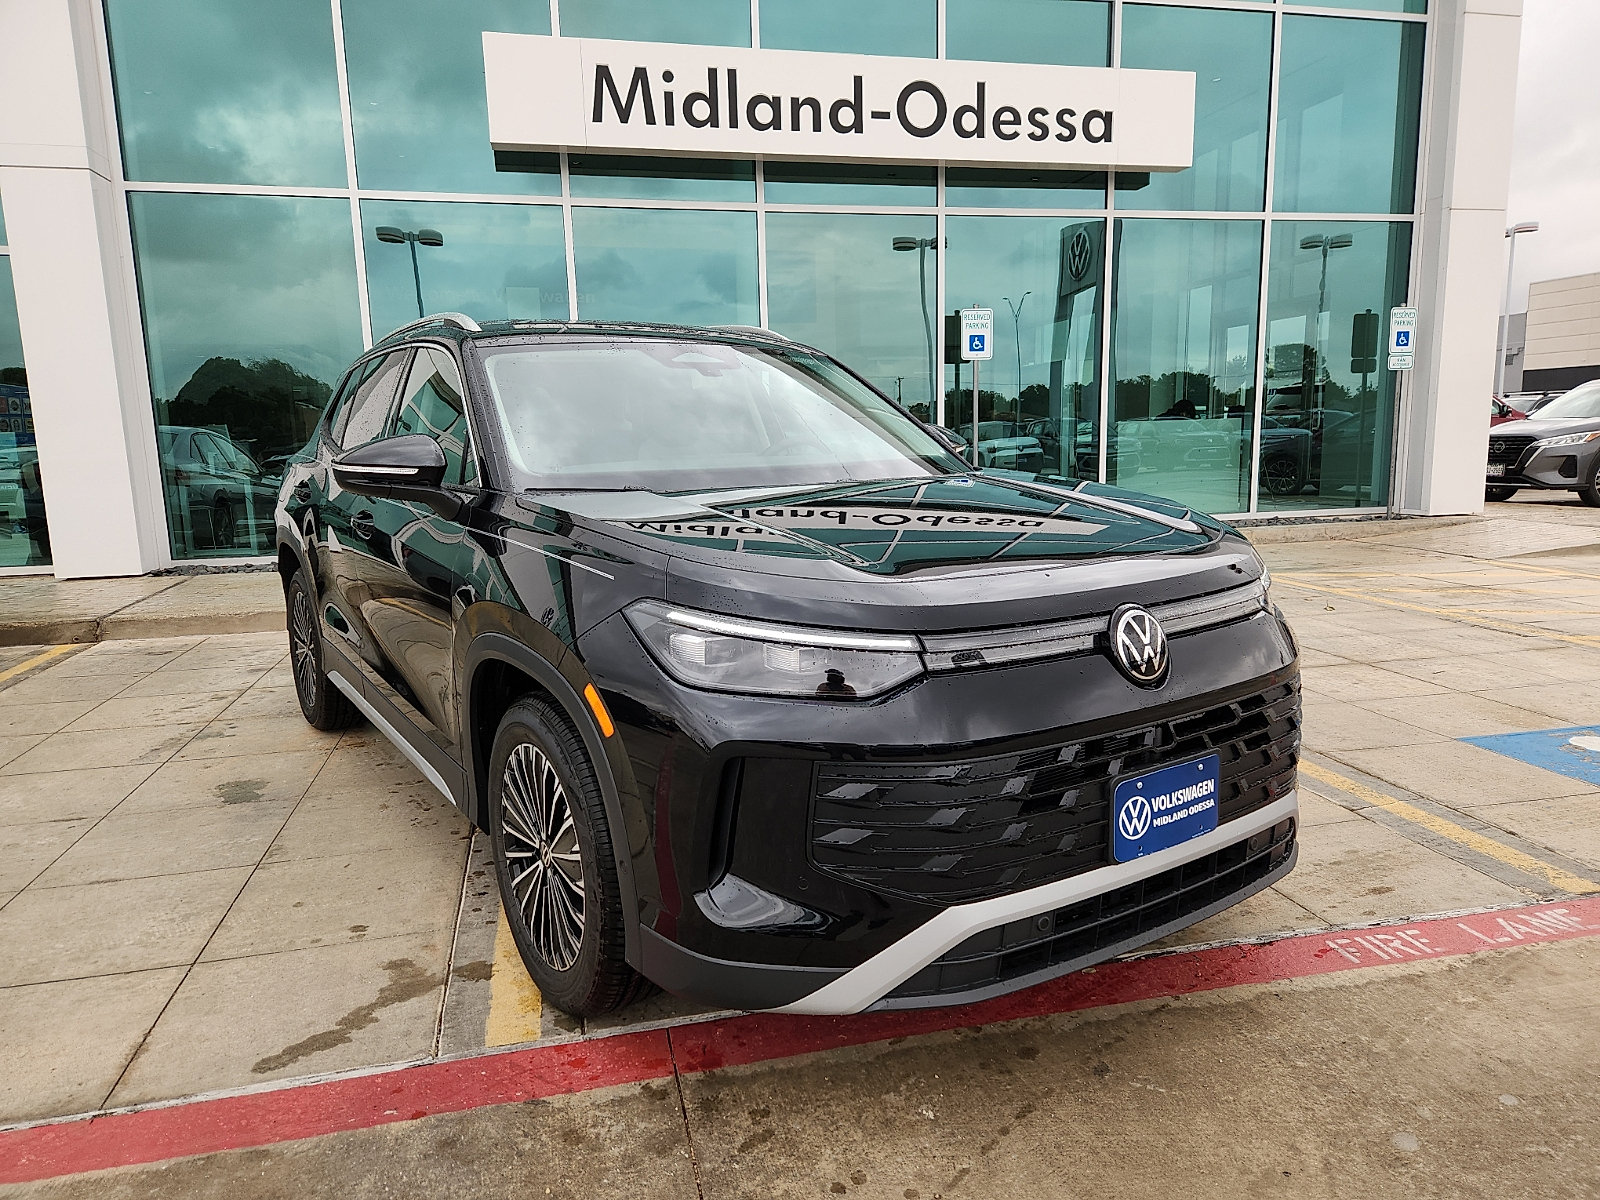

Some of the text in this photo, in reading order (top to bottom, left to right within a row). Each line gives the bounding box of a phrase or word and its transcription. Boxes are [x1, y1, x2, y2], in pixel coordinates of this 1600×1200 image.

[592, 64, 1114, 144] Midland-Odessa
[965, 322, 989, 330] PARKING
[1393, 311, 1416, 319] RESERVED
[1393, 319, 1414, 327] PARKING
[1151, 779, 1215, 812] VOLKSWAGEN
[1152, 798, 1215, 827] MIDLAND ODESSA
[1325, 929, 1437, 964] FIRE
